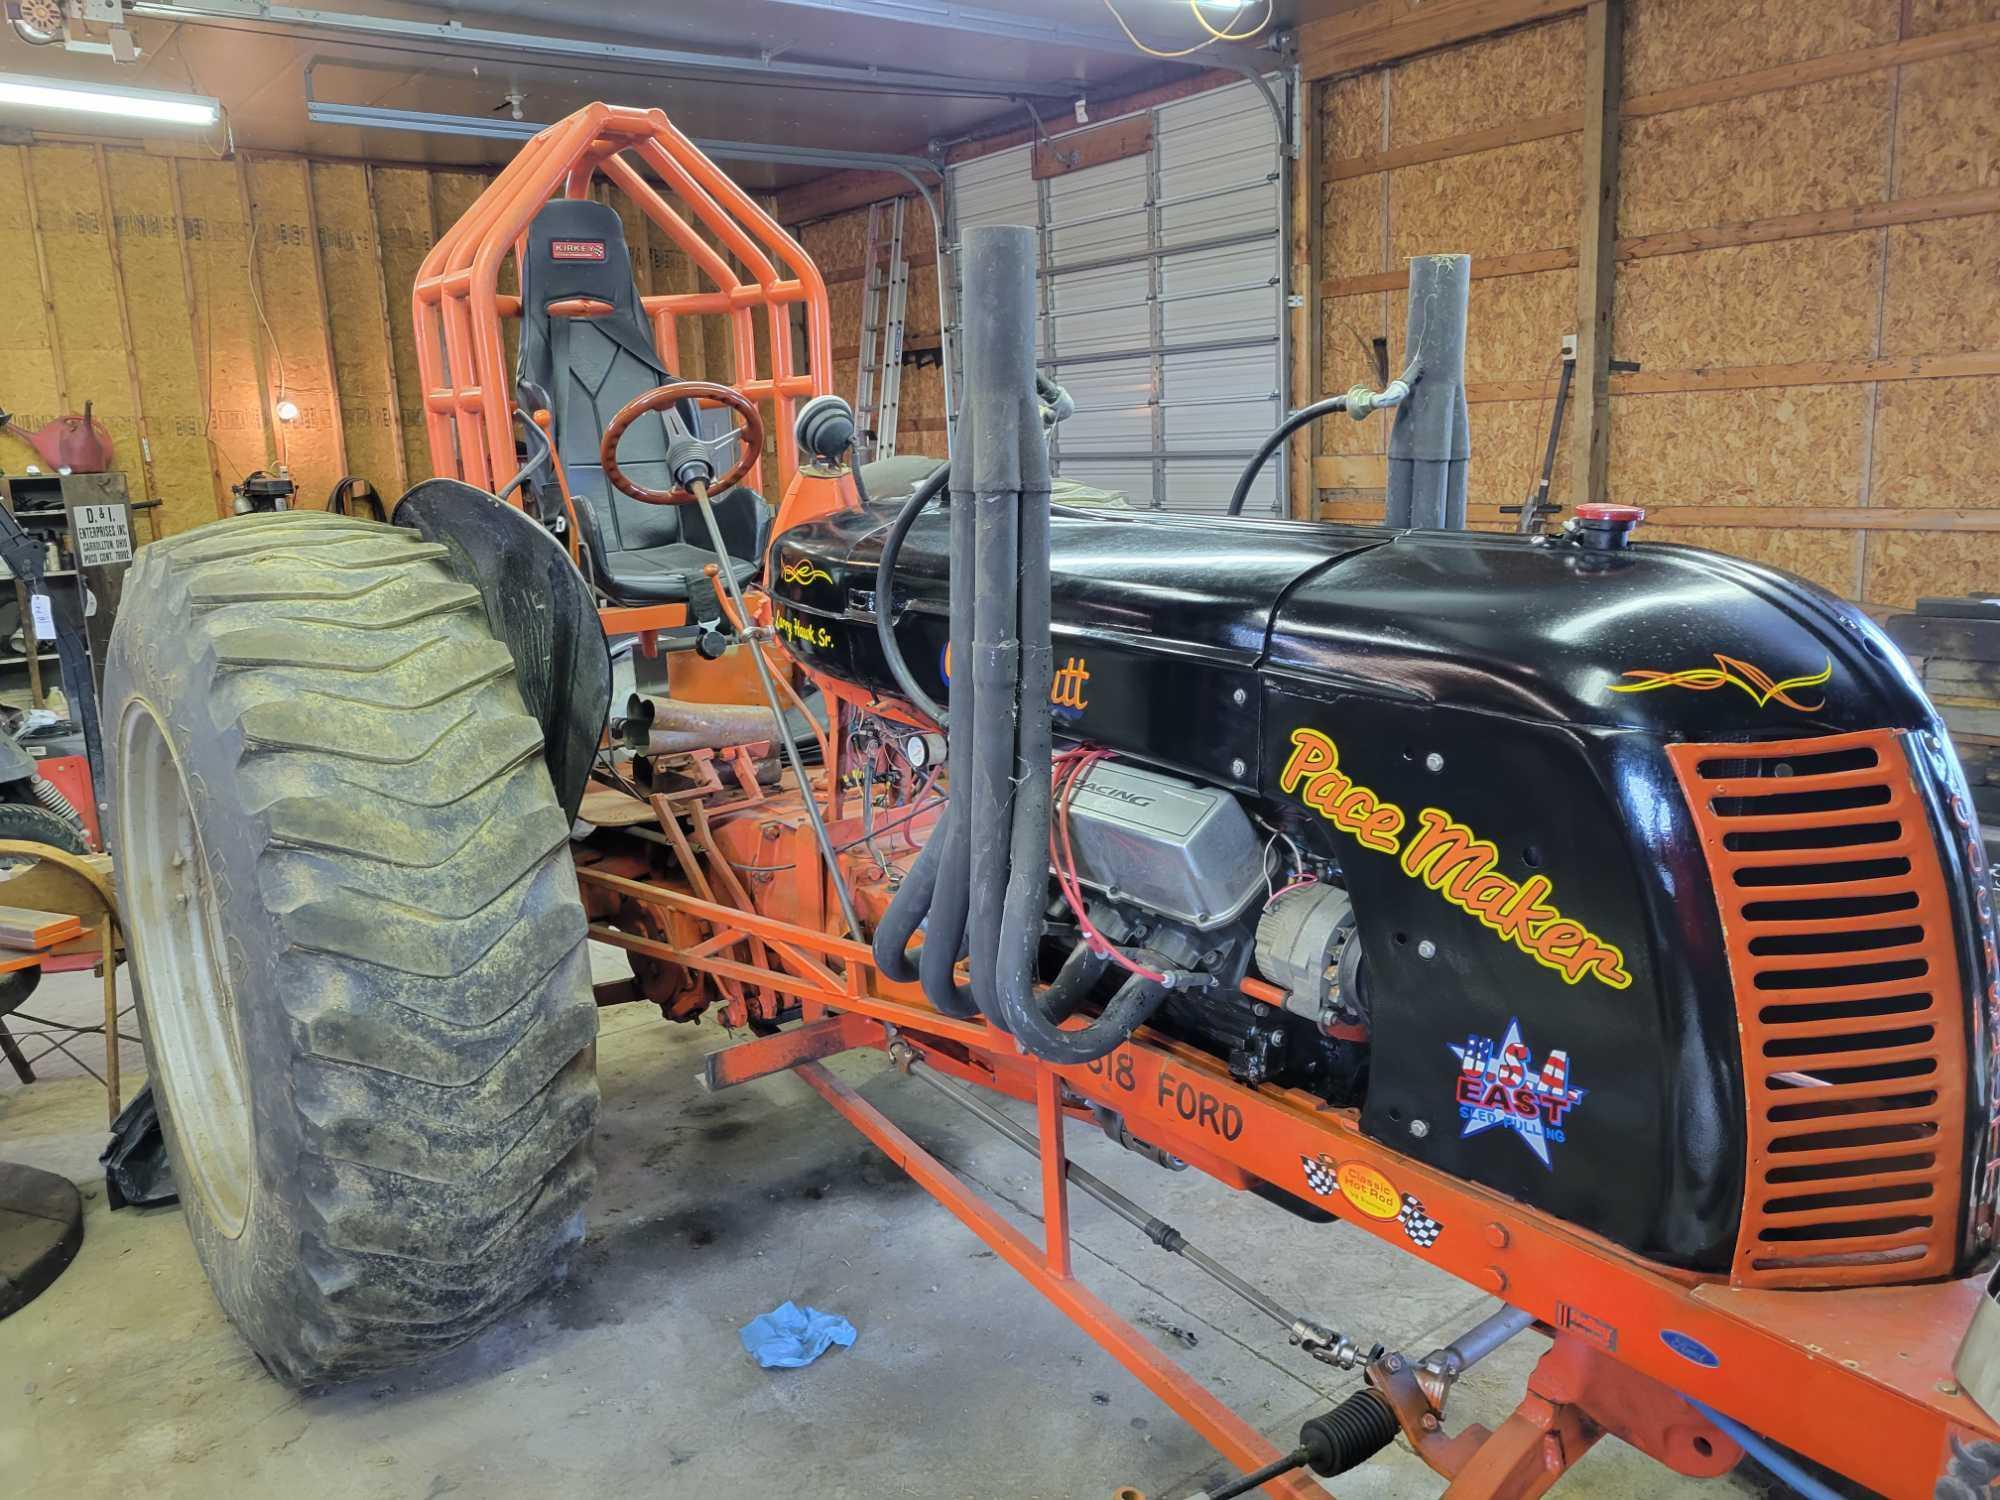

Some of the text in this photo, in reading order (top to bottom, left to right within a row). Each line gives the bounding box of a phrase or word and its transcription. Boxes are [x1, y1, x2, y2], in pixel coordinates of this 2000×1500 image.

[86, 506, 115, 523] D. & I.
[79, 525, 115, 539] ENTERPRISES
[116, 538, 128, 549] OHIO
[818, 628, 834, 648] Sr.
[1281, 728, 1633, 989] Pace Maker
[1158, 1071, 1243, 1141] FORD
[1456, 1076, 1571, 1125] EAST
[1459, 1106, 1566, 1142] SLED PULLNG
[1344, 1177, 1367, 1194] Hot
[1370, 1188, 1394, 1207] Rod
[1348, 1168, 1391, 1196] Classic
